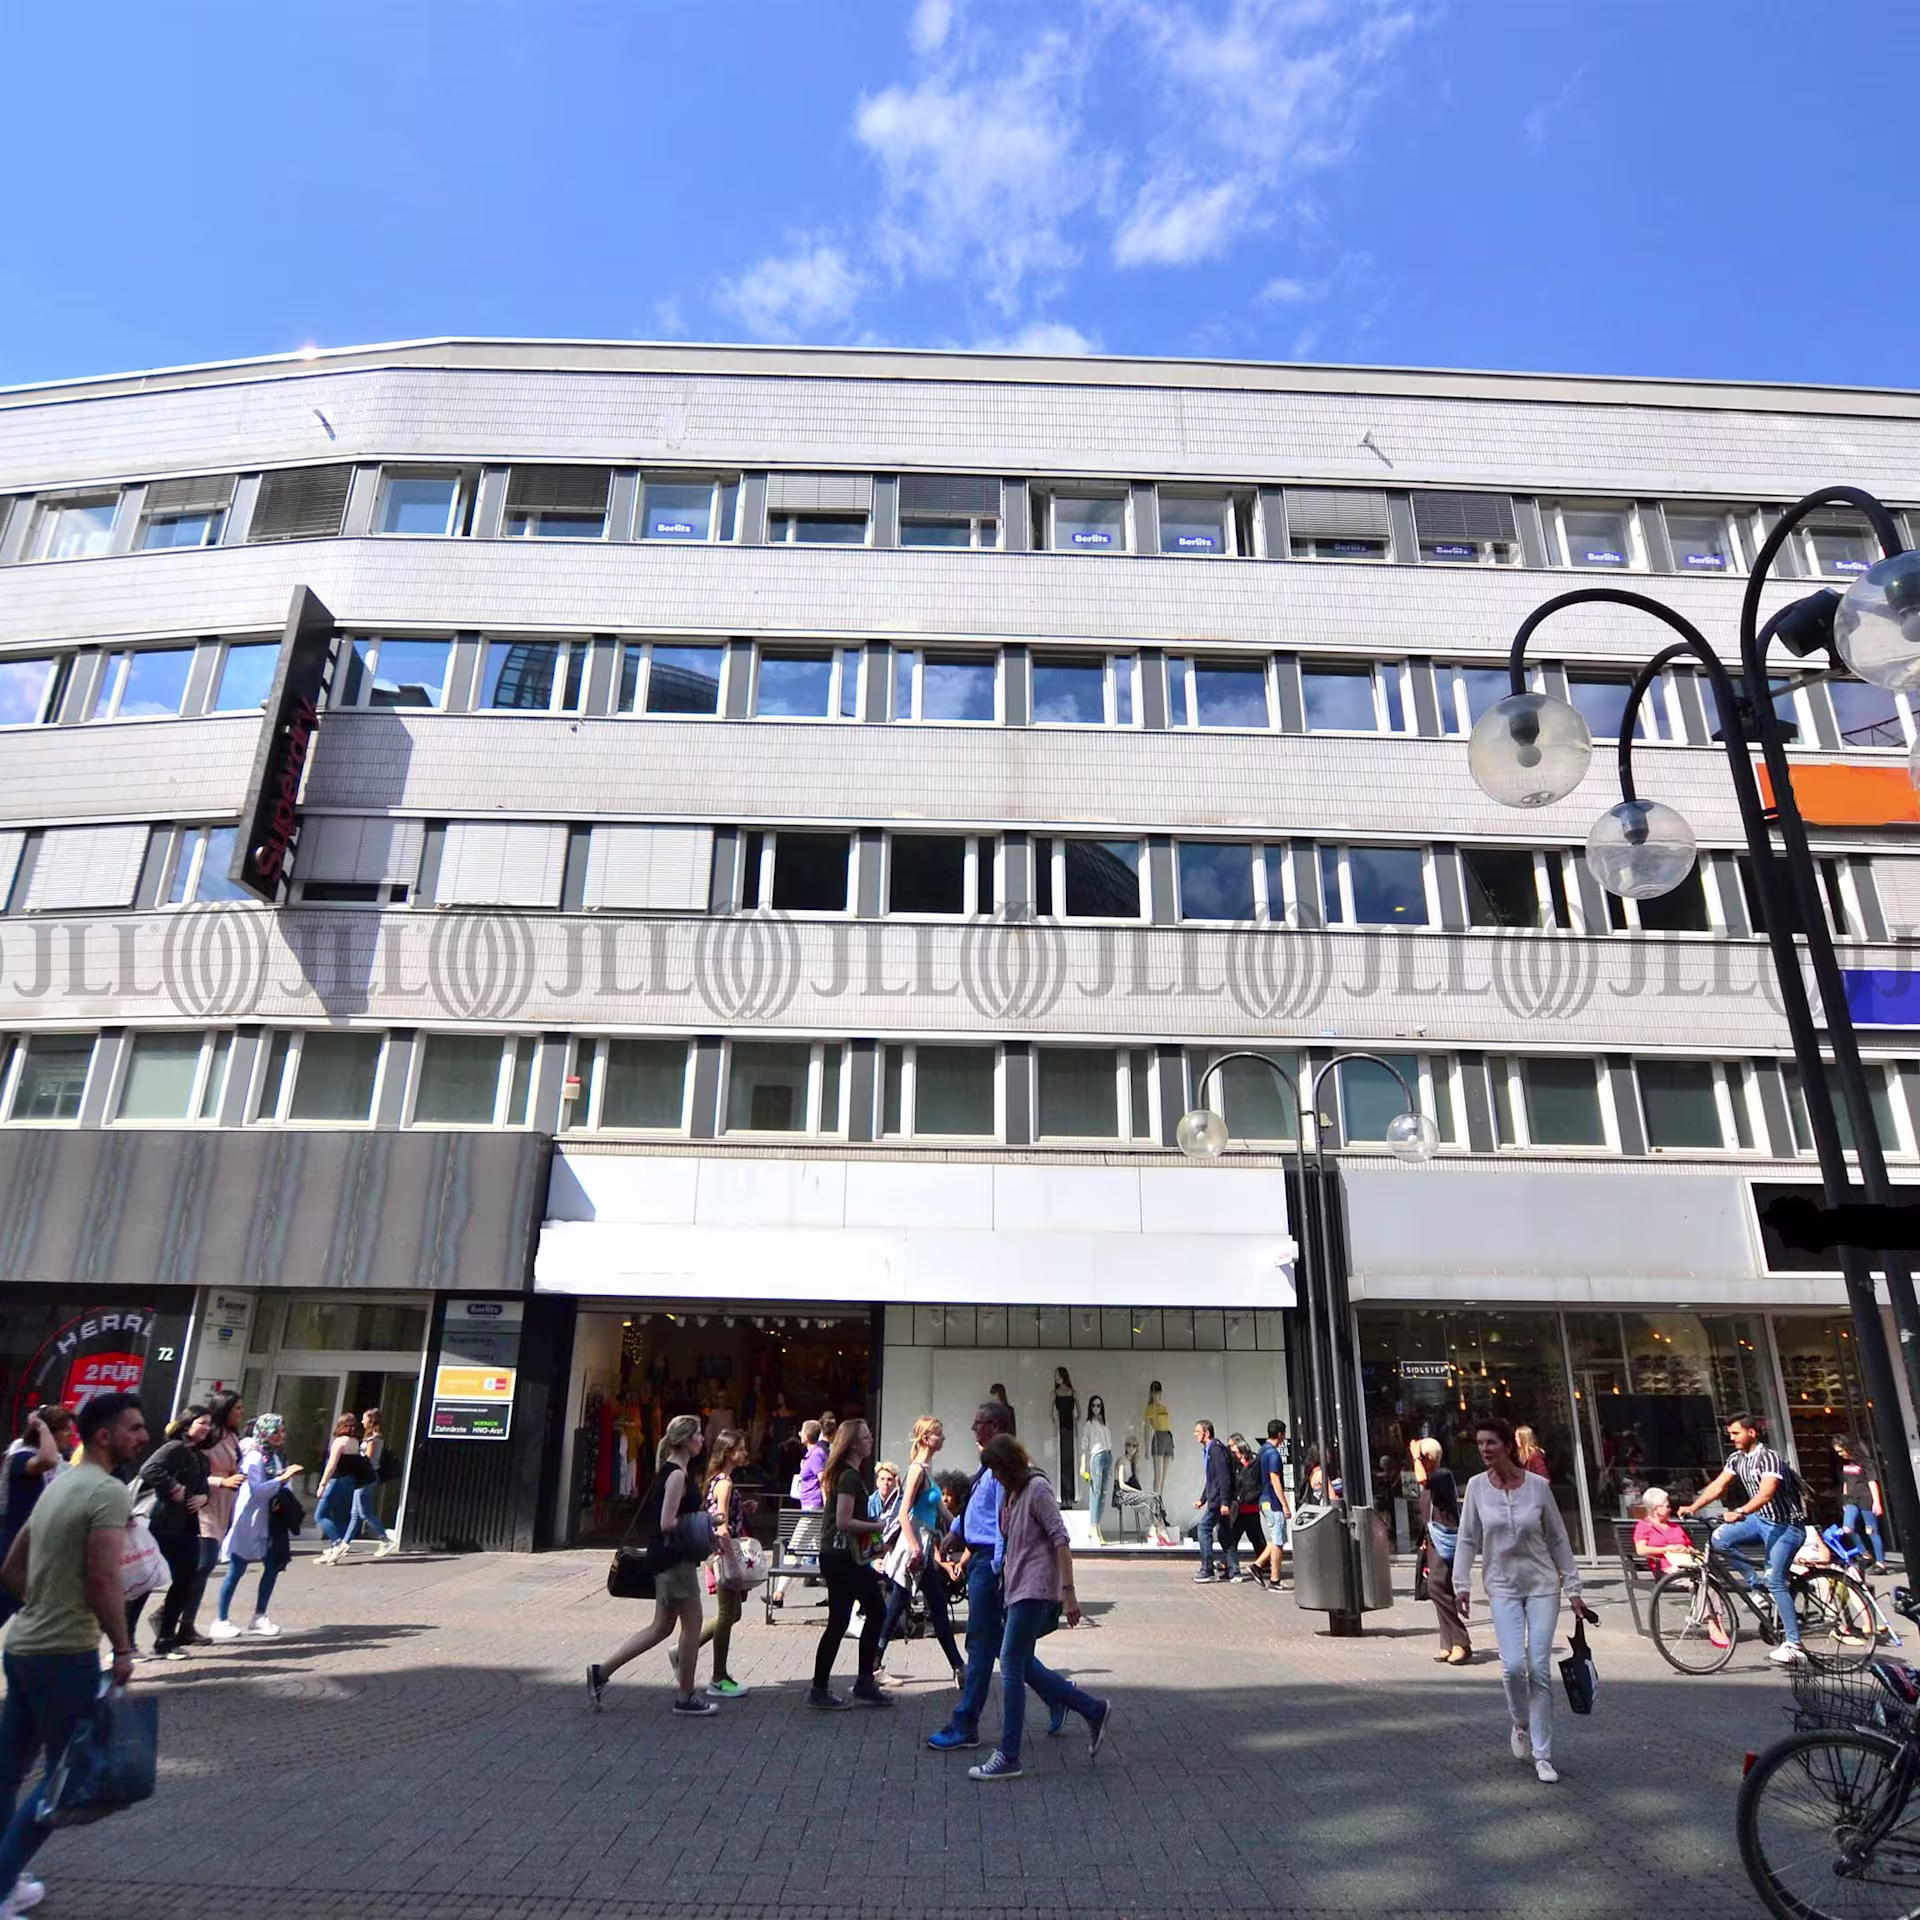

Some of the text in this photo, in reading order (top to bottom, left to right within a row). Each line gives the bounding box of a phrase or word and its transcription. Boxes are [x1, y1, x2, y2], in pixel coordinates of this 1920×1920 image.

[657, 524, 691, 533] Berlitz
[1074, 534, 1109, 543] Berlitz
[1178, 538, 1212, 547] Berlitz
[1587, 553, 1621, 562] Berlitz
[1688, 556, 1722, 565] Berlitz
[1835, 561, 1869, 571] Berlitz
[158, 1347, 175, 1361] 72
[84, 1360, 140, 1381] 2 FÜR
[433, 1425, 504, 1435] Zahnärzte HNO-Arzt
